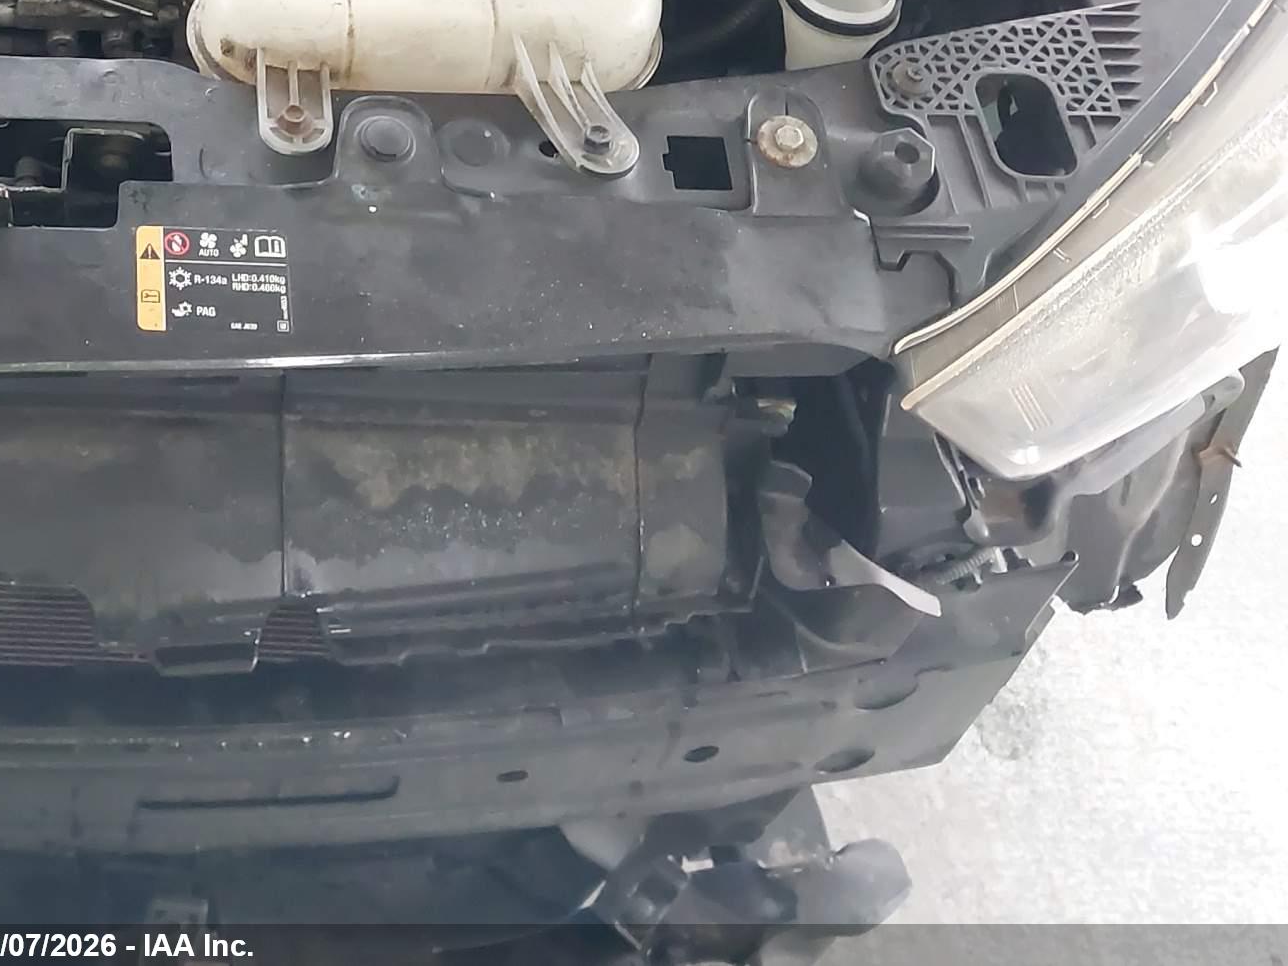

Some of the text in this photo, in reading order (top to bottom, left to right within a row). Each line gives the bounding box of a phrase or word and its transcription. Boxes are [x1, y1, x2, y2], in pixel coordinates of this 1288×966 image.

[198, 248, 220, 257] AUTO
[193, 274, 228, 286] R-134a
[196, 306, 217, 318] PAG
